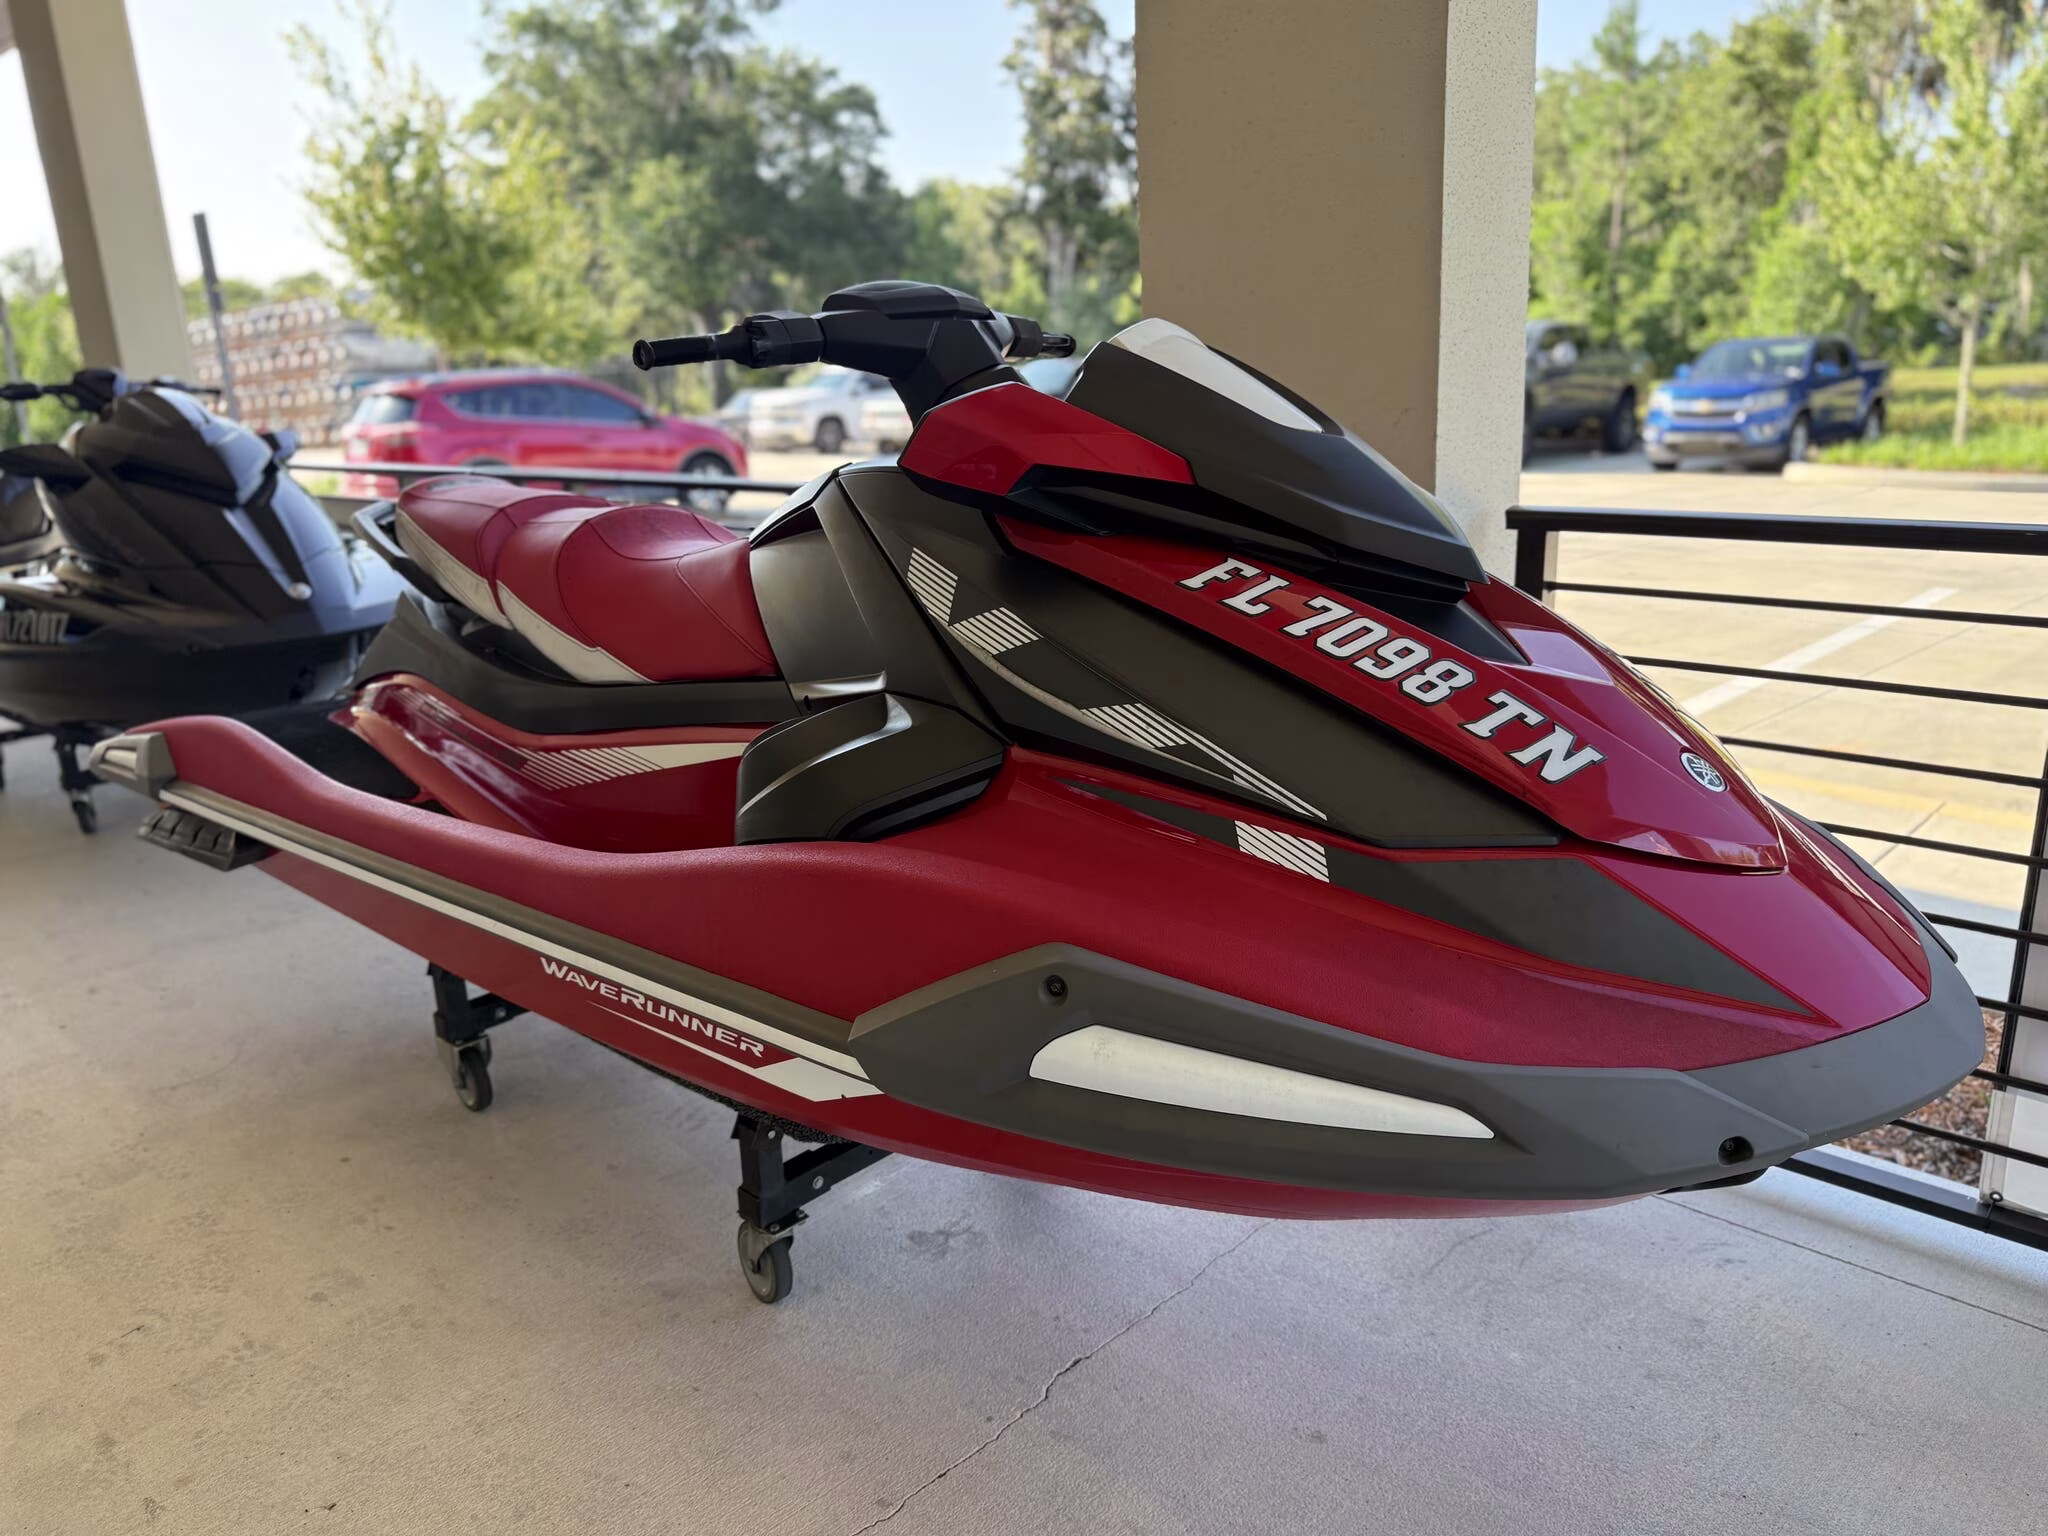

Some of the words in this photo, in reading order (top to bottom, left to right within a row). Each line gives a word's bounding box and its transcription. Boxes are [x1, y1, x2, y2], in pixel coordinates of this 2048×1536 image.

[1179, 557, 1292, 616] FL
[1282, 595, 1476, 704] 7098
[1461, 689, 1607, 784] TN
